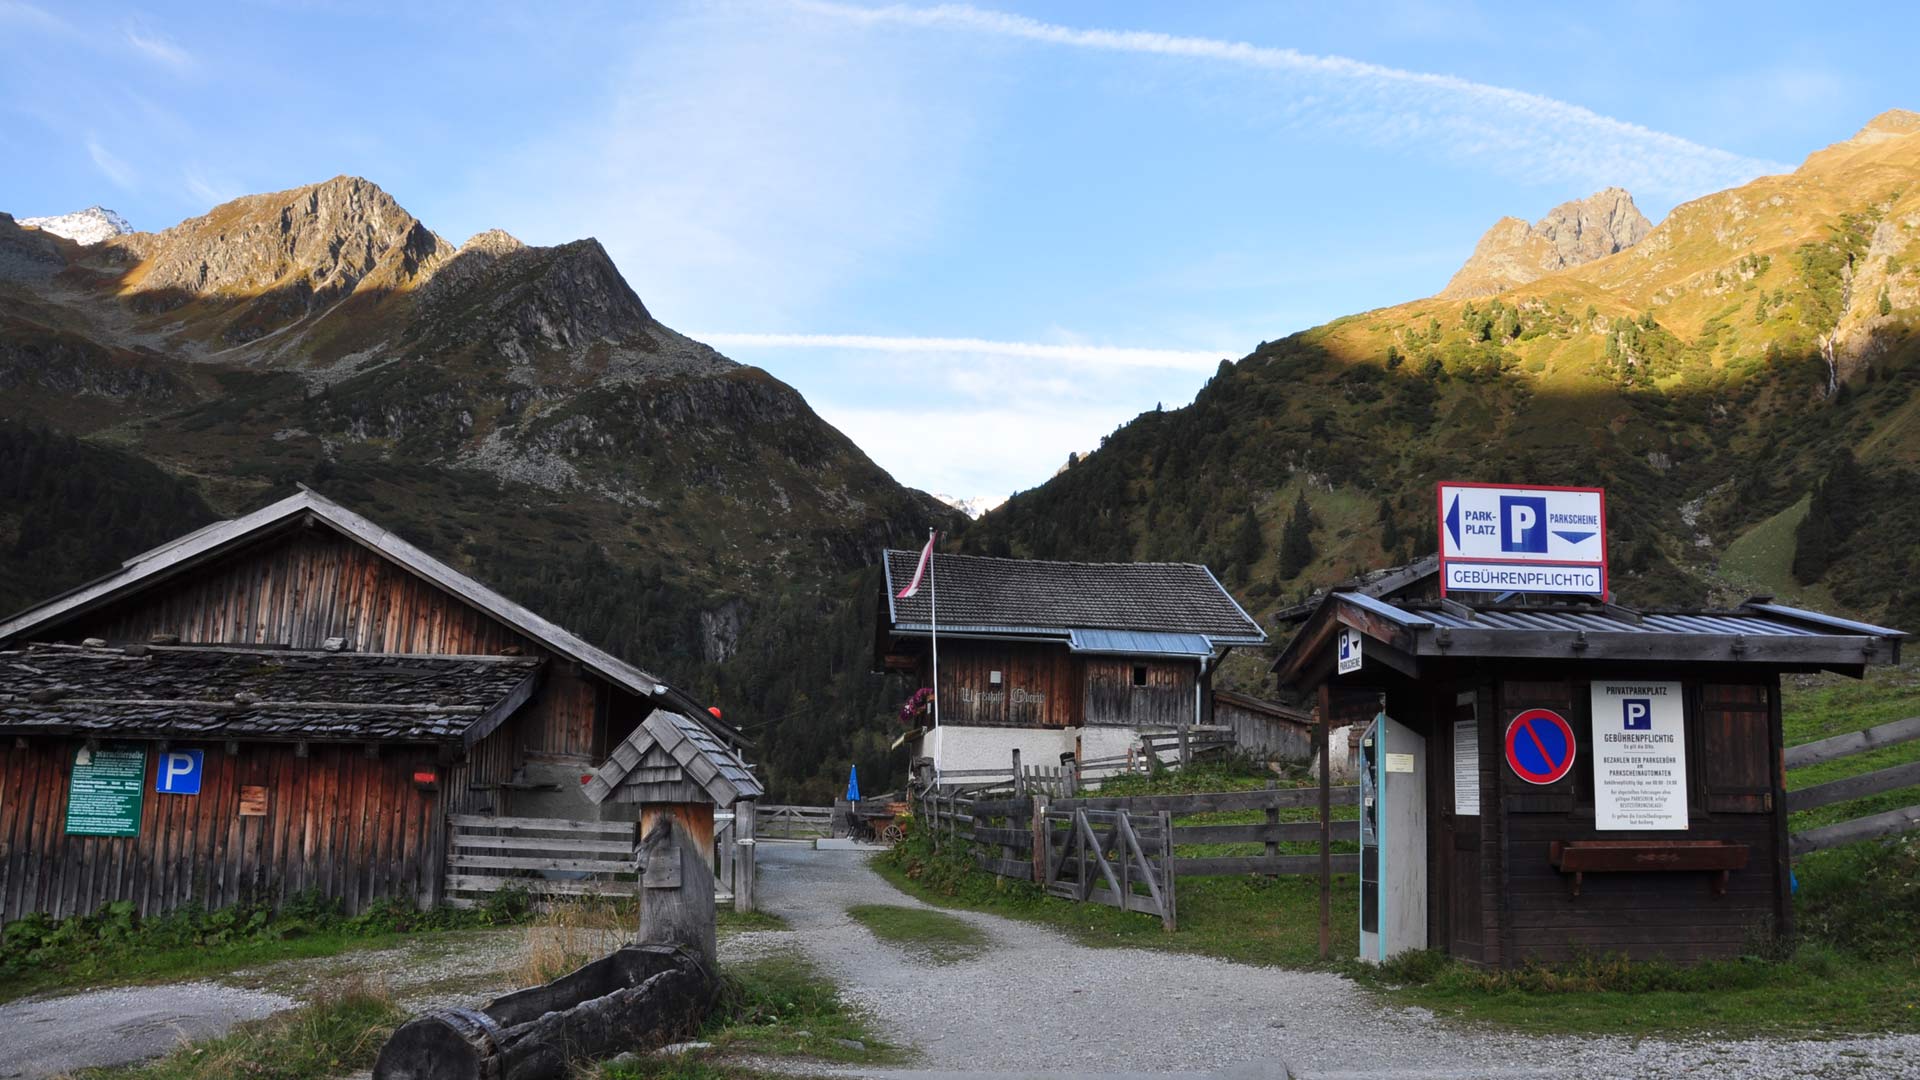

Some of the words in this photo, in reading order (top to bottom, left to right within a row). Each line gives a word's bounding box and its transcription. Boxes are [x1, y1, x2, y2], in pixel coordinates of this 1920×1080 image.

[1465, 510, 1497, 521] PARK-
[1550, 513, 1598, 526] PARKSCHEINE
[1465, 524, 1496, 535] PLATZ
[1510, 505, 1536, 544] P
[1454, 568, 1594, 587] GEBÜHRENPFLICHTIG
[1341, 634, 1348, 656] P
[1606, 686, 1668, 696] PRIVATPARKPLATZ
[1628, 703, 1646, 726] P
[1604, 733, 1674, 743] GEBÜHRENPFLICHTIG
[1642, 756, 1676, 764] PARKGEBÜHR
[165, 753, 194, 790] P
